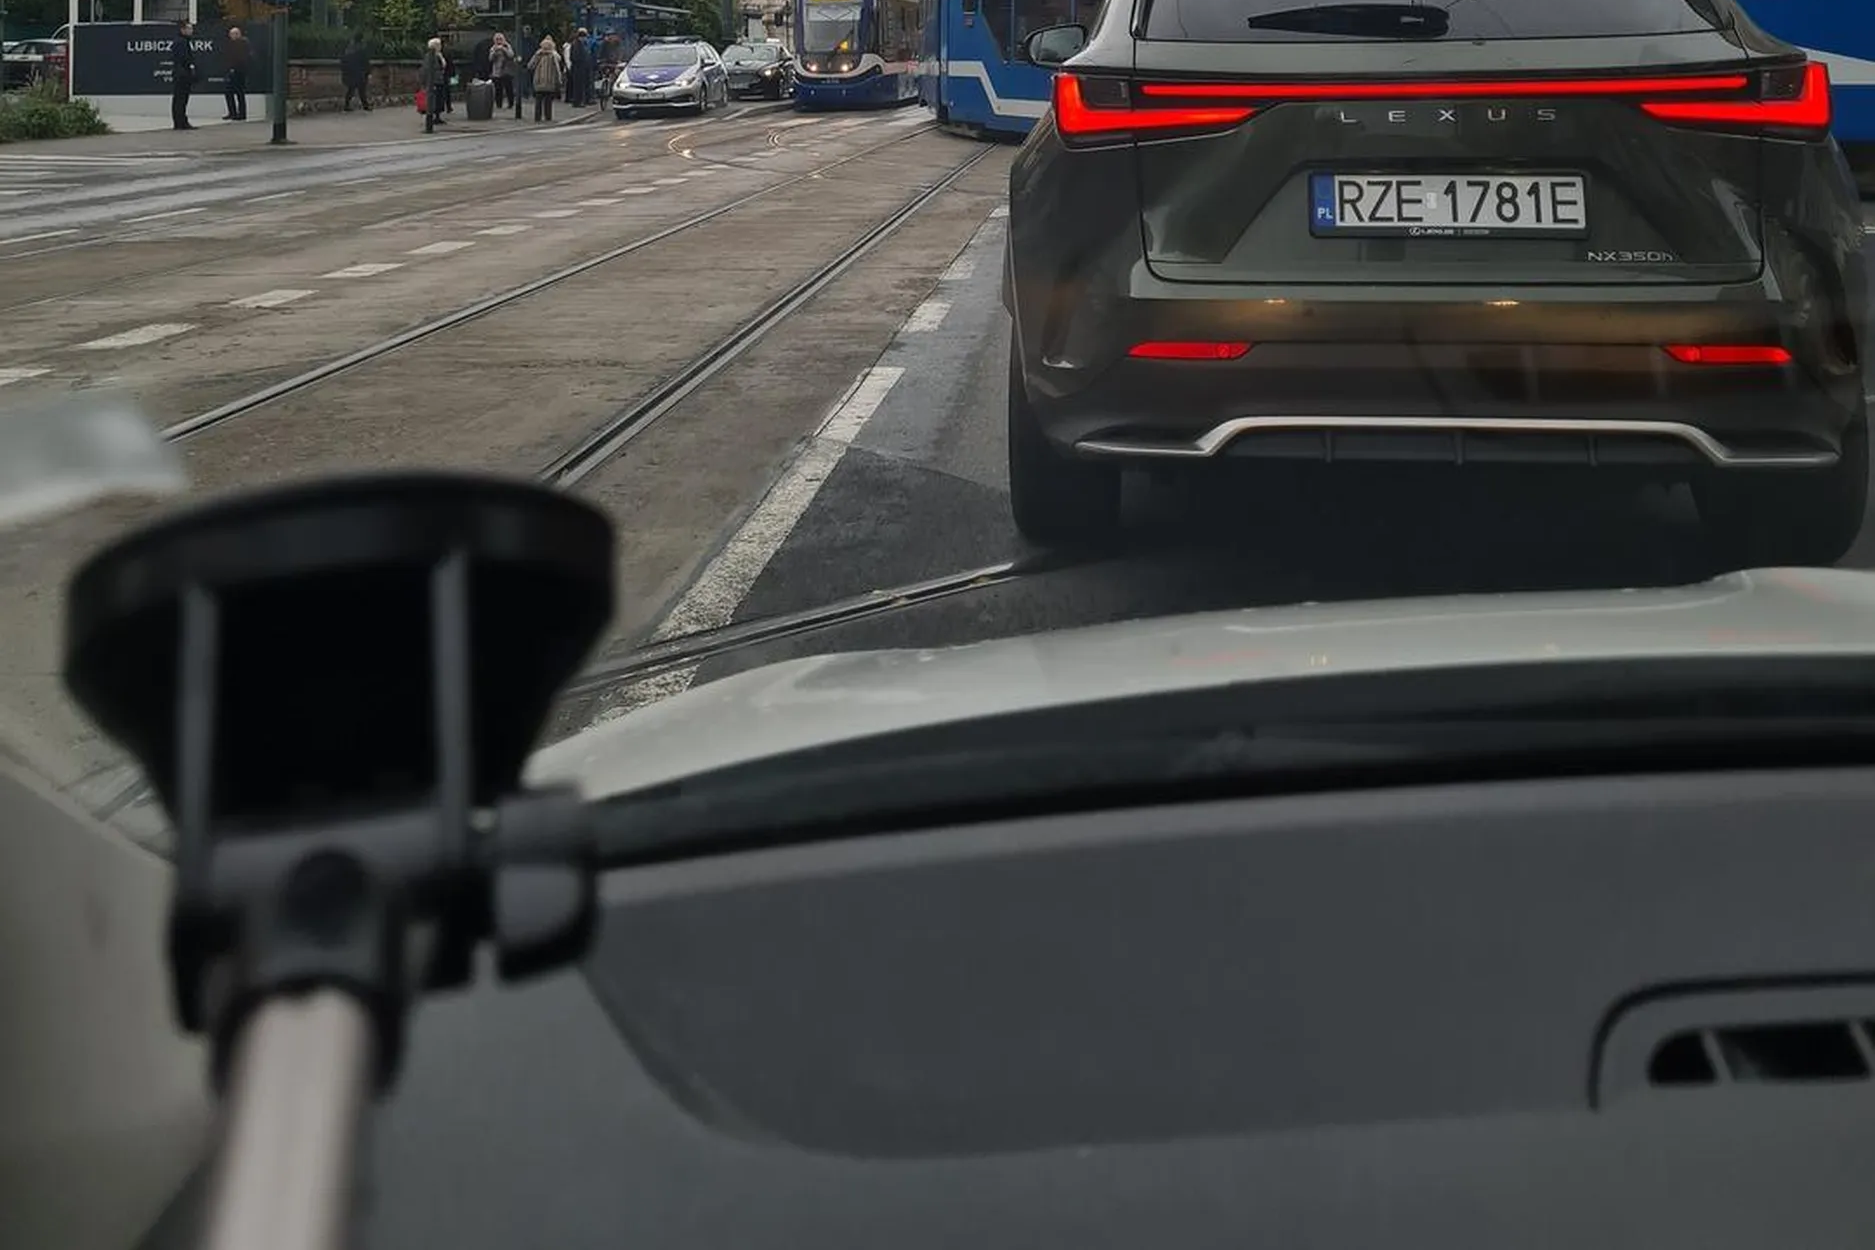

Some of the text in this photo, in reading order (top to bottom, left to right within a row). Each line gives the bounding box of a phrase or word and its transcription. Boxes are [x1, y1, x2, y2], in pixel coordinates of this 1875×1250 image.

[127, 40, 214, 52] LUBICZ RK
[1340, 108, 1556, 123] LEXUS
[1338, 180, 1580, 225] RZE 1781E
[1317, 207, 1333, 220] PL
[1587, 251, 1674, 262] NX350h
